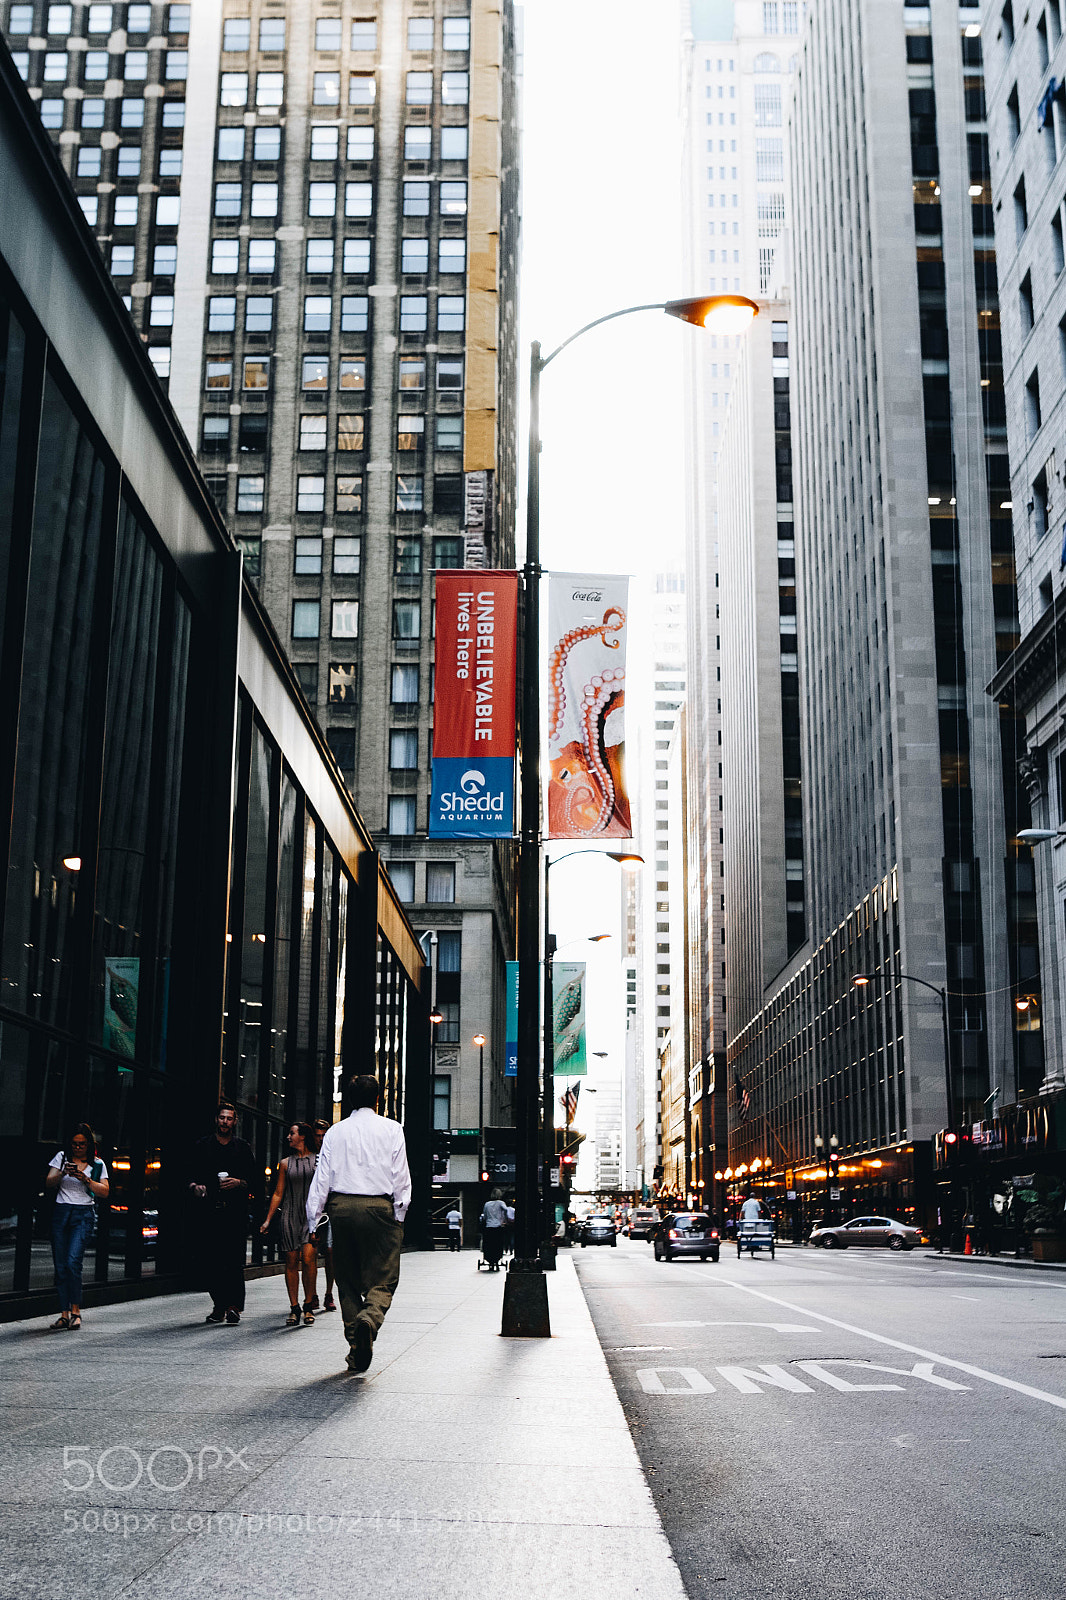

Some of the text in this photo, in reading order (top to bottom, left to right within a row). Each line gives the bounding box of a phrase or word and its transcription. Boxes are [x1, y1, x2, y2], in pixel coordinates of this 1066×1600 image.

[457, 592, 474, 679] lives here
[475, 591, 495, 741] UNBELIEVABLE
[440, 792, 504, 812] Shedd
[636, 1362, 973, 1394] ONLY
